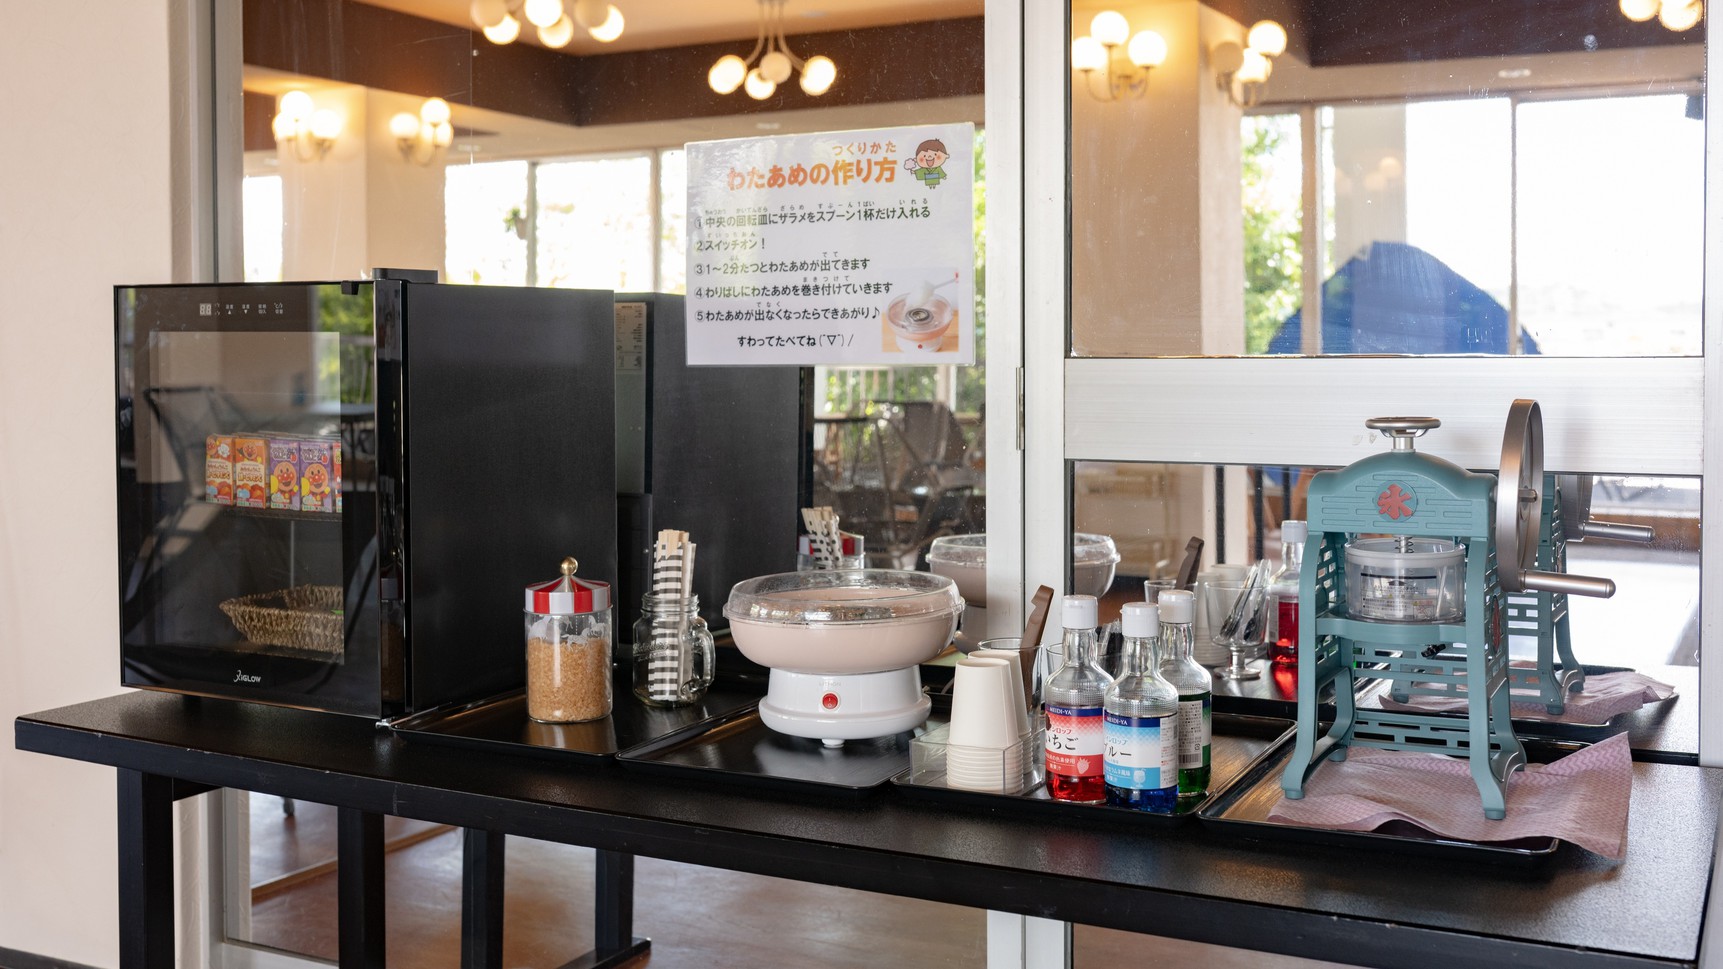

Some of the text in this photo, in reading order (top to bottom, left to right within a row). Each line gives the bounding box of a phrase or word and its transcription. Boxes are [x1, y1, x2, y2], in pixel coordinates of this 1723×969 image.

[832, 141, 897, 156] つくりかた
[727, 157, 898, 191] わたあめの作り方
[1377, 483, 1415, 520] 氷
